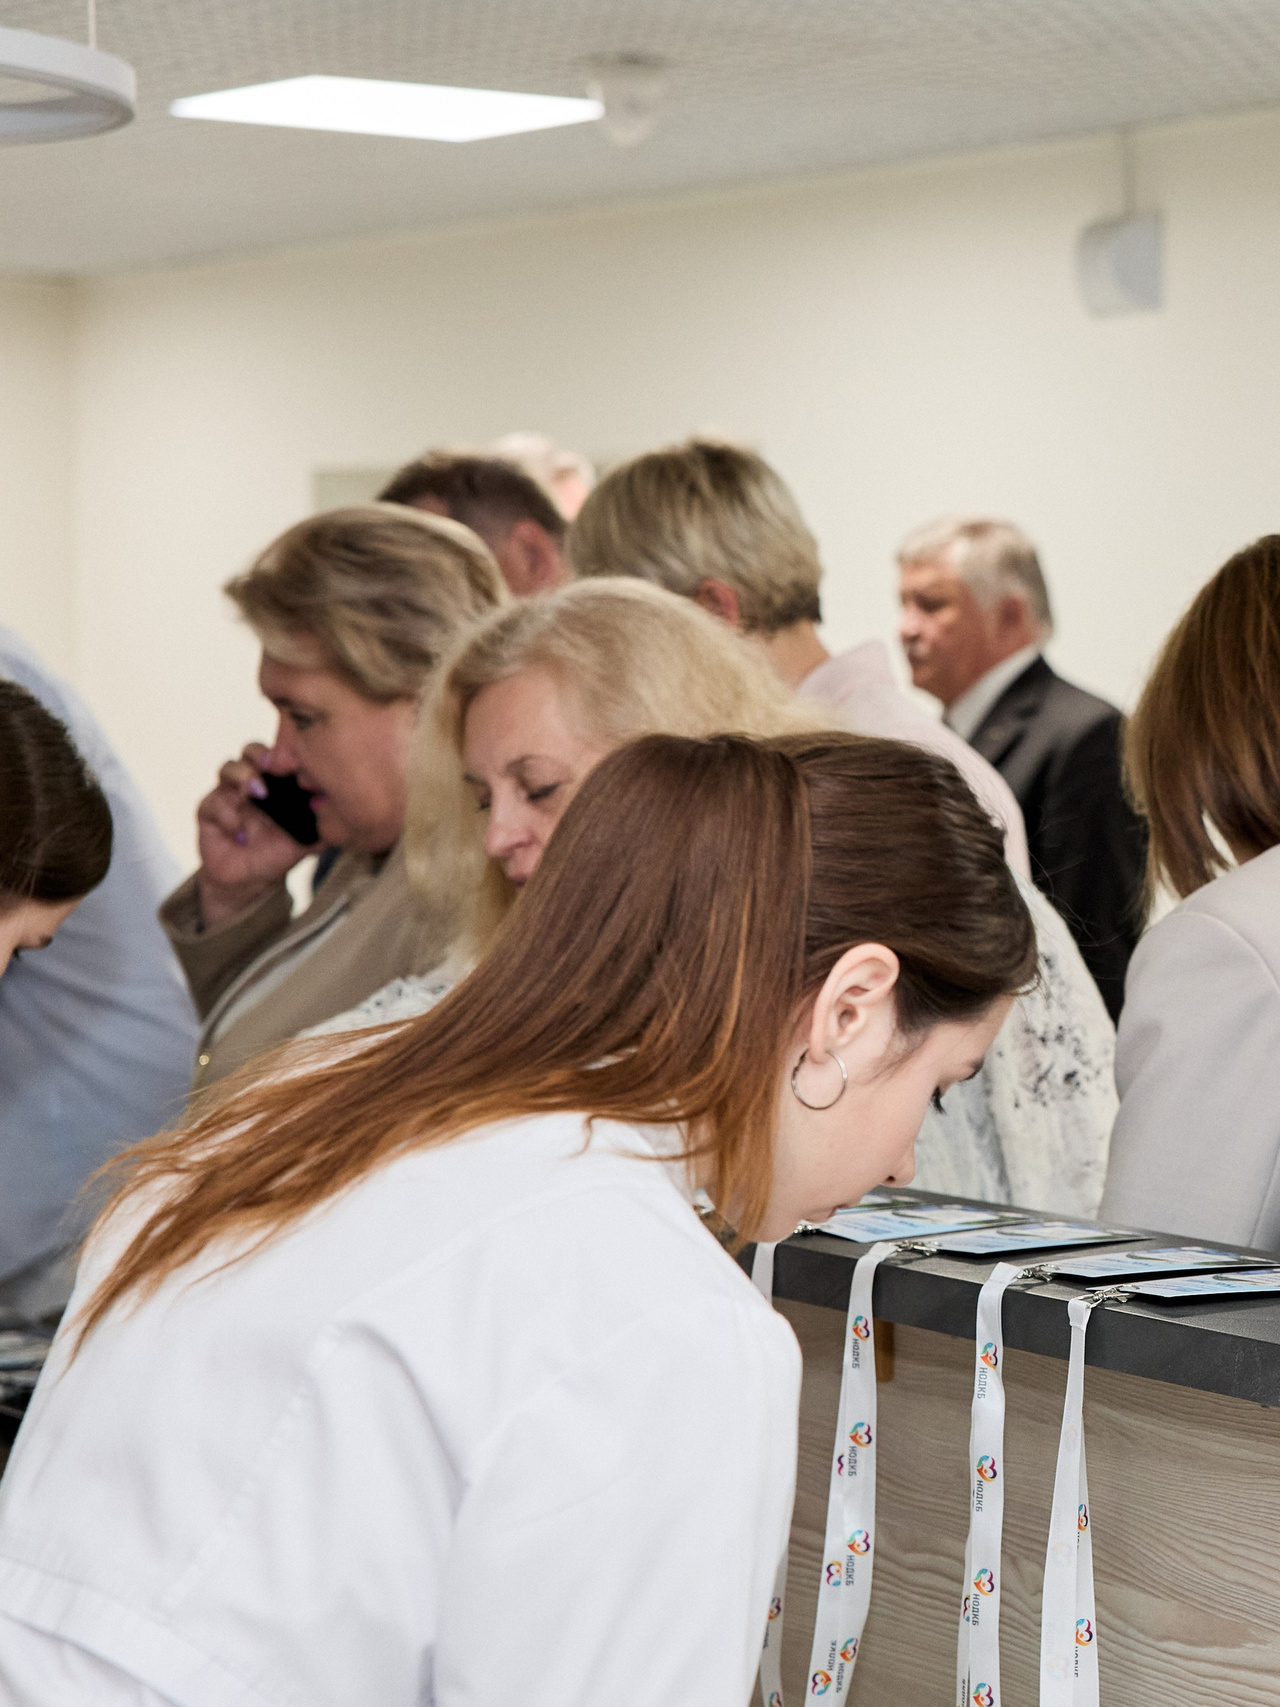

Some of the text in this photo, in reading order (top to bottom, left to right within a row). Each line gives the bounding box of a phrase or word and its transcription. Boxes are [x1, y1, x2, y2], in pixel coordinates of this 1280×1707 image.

[851, 1338, 860, 1369] НОДКБ
[977, 1367, 988, 1399] НОДКБ
[847, 1446, 857, 1477] НОДКБ
[975, 1480, 984, 1512] НОДКБ
[845, 1555, 855, 1586] НОДКБ
[972, 1593, 981, 1626] НОДКБ
